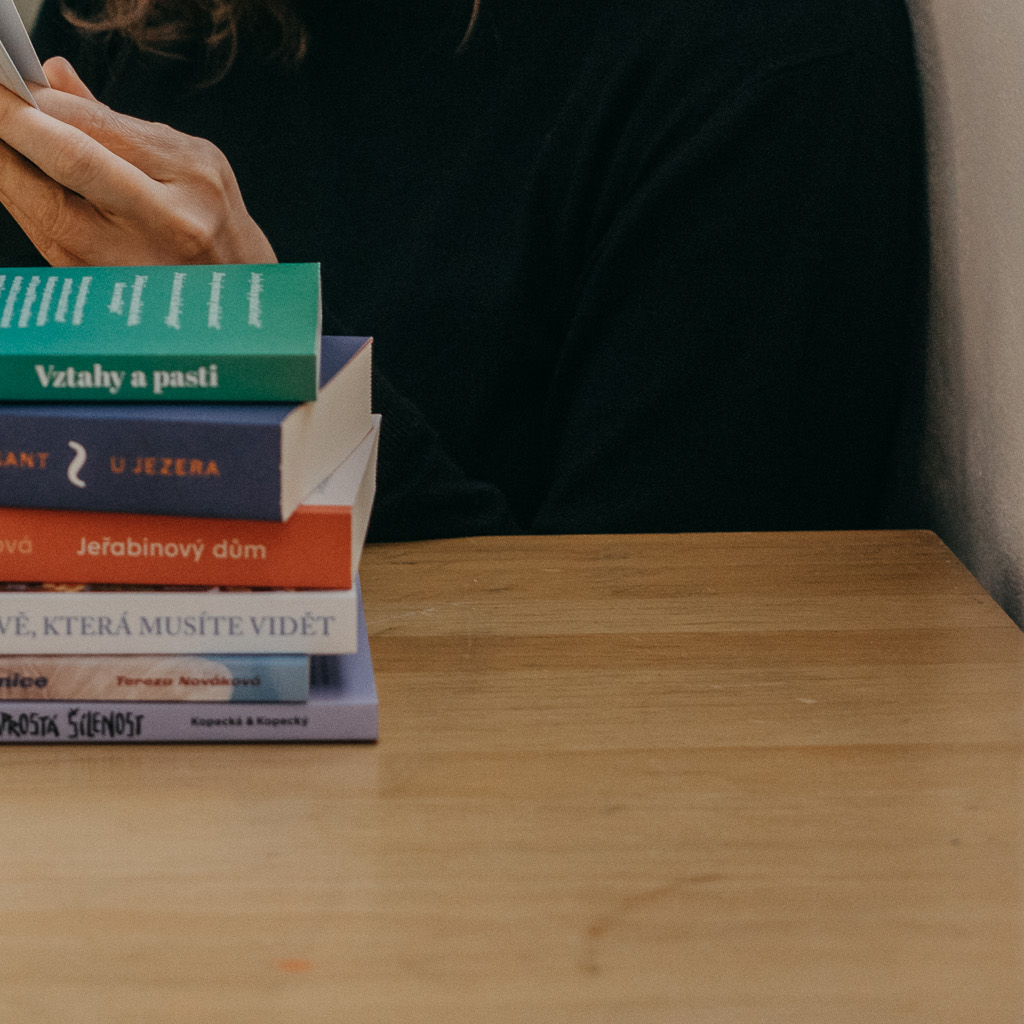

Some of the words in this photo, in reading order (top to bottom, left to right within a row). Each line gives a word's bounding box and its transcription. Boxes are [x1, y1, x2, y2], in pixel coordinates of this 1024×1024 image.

[34, 363, 126, 395] Vztahy
[130, 370, 147, 389] a
[152, 364, 220, 395] pasti
[109, 456, 125, 474] U
[131, 457, 221, 476] JEZERA
[76, 536, 205, 562] Jeřabinový
[211, 537, 267, 560] dům
[43, 611, 132, 637] KTERÁ
[139, 611, 243, 637] MUSÍTE
[249, 611, 336, 637] VIDĚT
[116, 674, 175, 688] Tereza
[178, 673, 262, 688] Nováková
[190, 715, 245, 728] Kopecká
[246, 716, 255, 727] &
[256, 715, 309, 729] Kopecký
